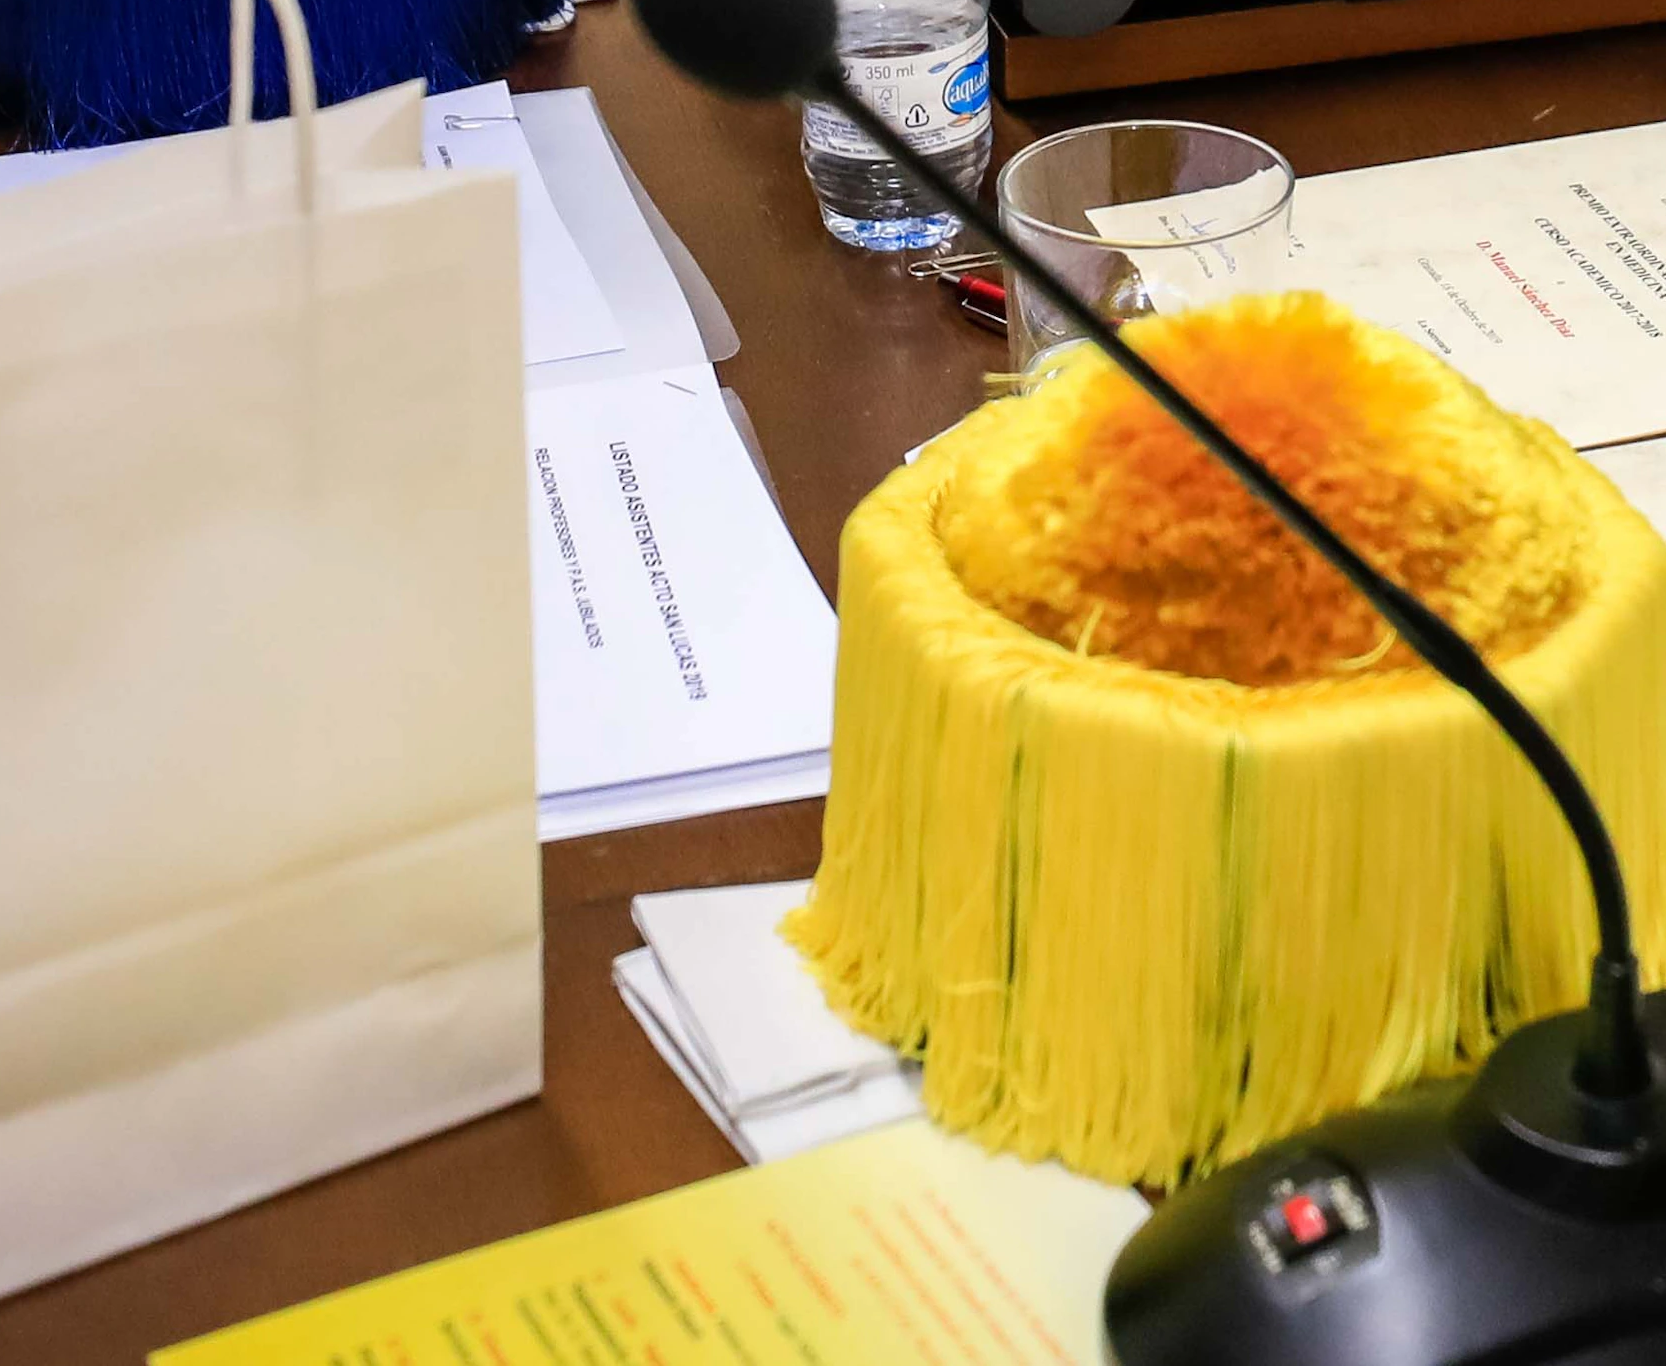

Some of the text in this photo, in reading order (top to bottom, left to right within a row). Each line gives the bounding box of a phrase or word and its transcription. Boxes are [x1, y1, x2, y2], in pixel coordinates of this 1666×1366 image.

[865, 63, 915, 80] 350 ml
[1569, 184, 1609, 215] PREMIO
[1606, 242, 1623, 253] EN
[1476, 241, 1492, 251] D.
[1490, 252, 1526, 283] Manuel
[1517, 284, 1555, 317] Sánchez
[1535, 218, 1663, 337] CURSO ACADEMICO 2017-2018
[610, 442, 638, 492] LISTADO
[535, 448, 557, 495] RELACION
[549, 497, 576, 559] PROFESORES
[576, 597, 604, 648] JUBILADOS
[626, 497, 662, 567] ASISTENTES
[649, 571, 673, 601] ACTO
[660, 604, 681, 628] SAN
[669, 631, 697, 670] LUCAS
